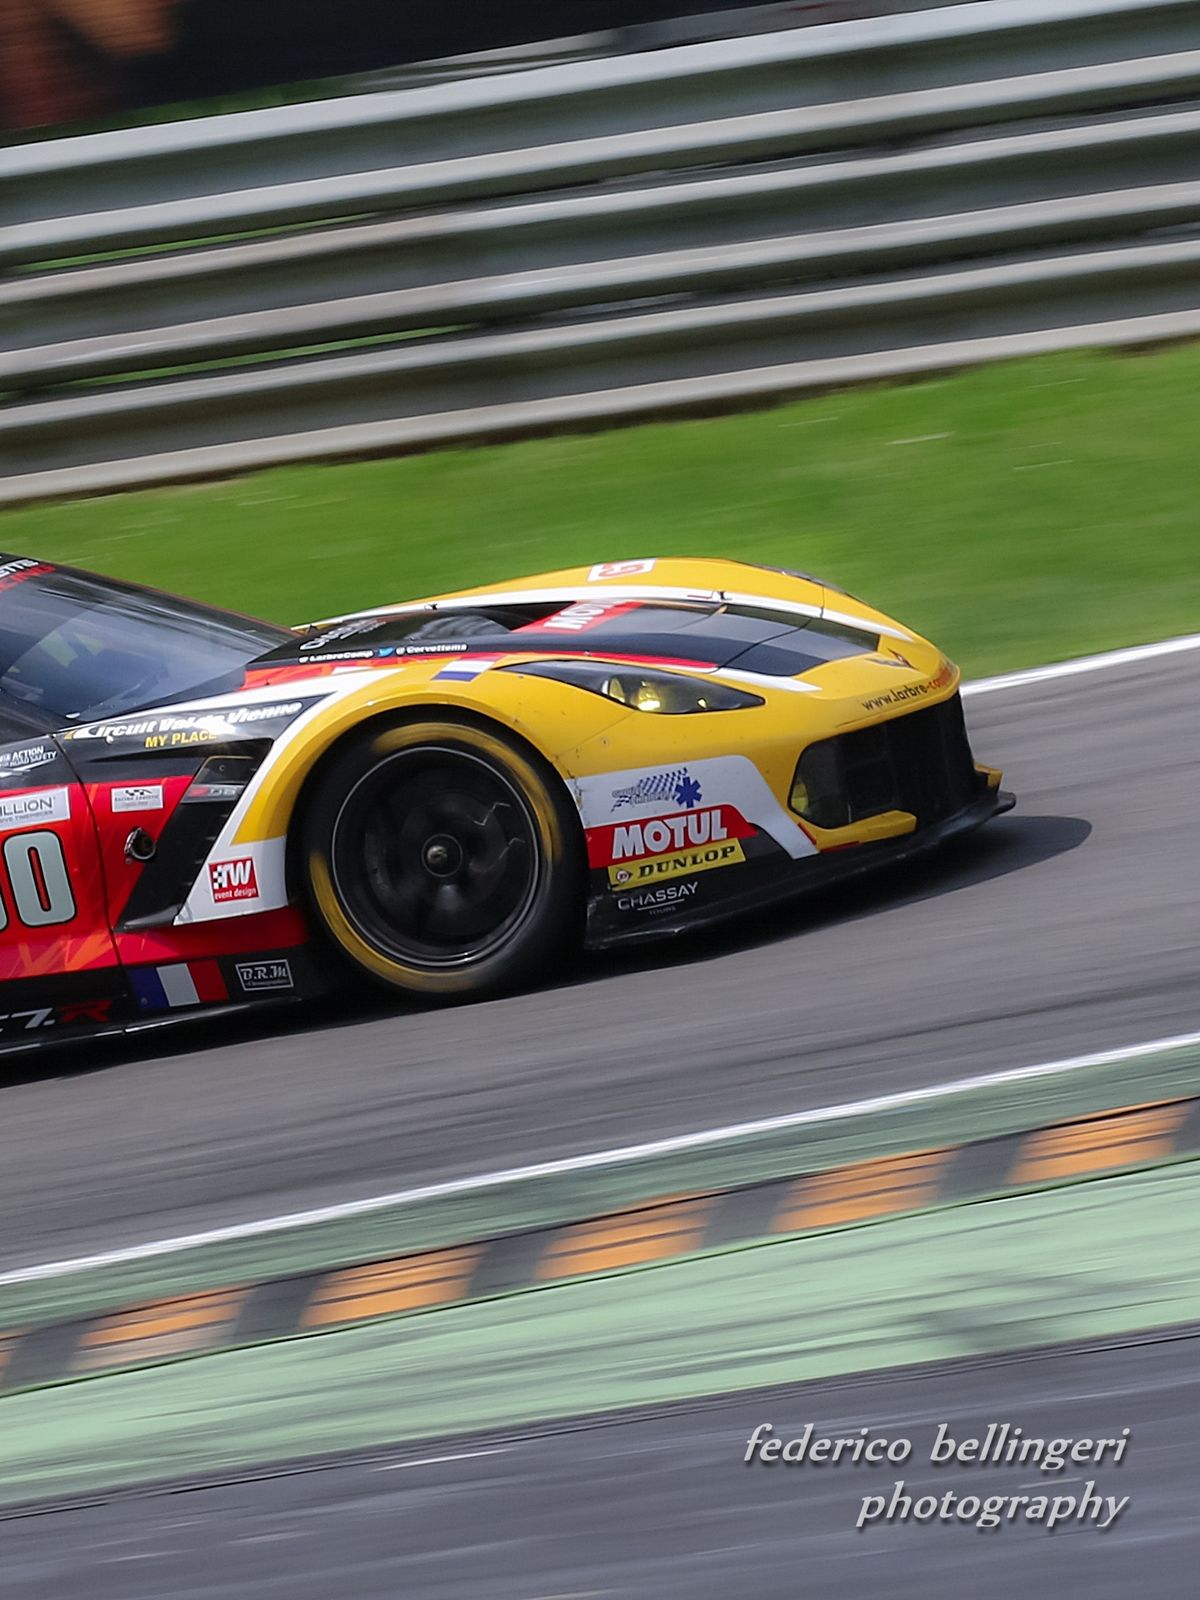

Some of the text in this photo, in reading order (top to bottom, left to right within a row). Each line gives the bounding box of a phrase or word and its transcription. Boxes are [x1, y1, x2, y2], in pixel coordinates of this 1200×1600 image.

[143, 729, 218, 748] MY PLACE
[612, 809, 728, 860] MOTUL
[638, 845, 736, 878] DUNLOP
[617, 881, 699, 910] CHASSAY
